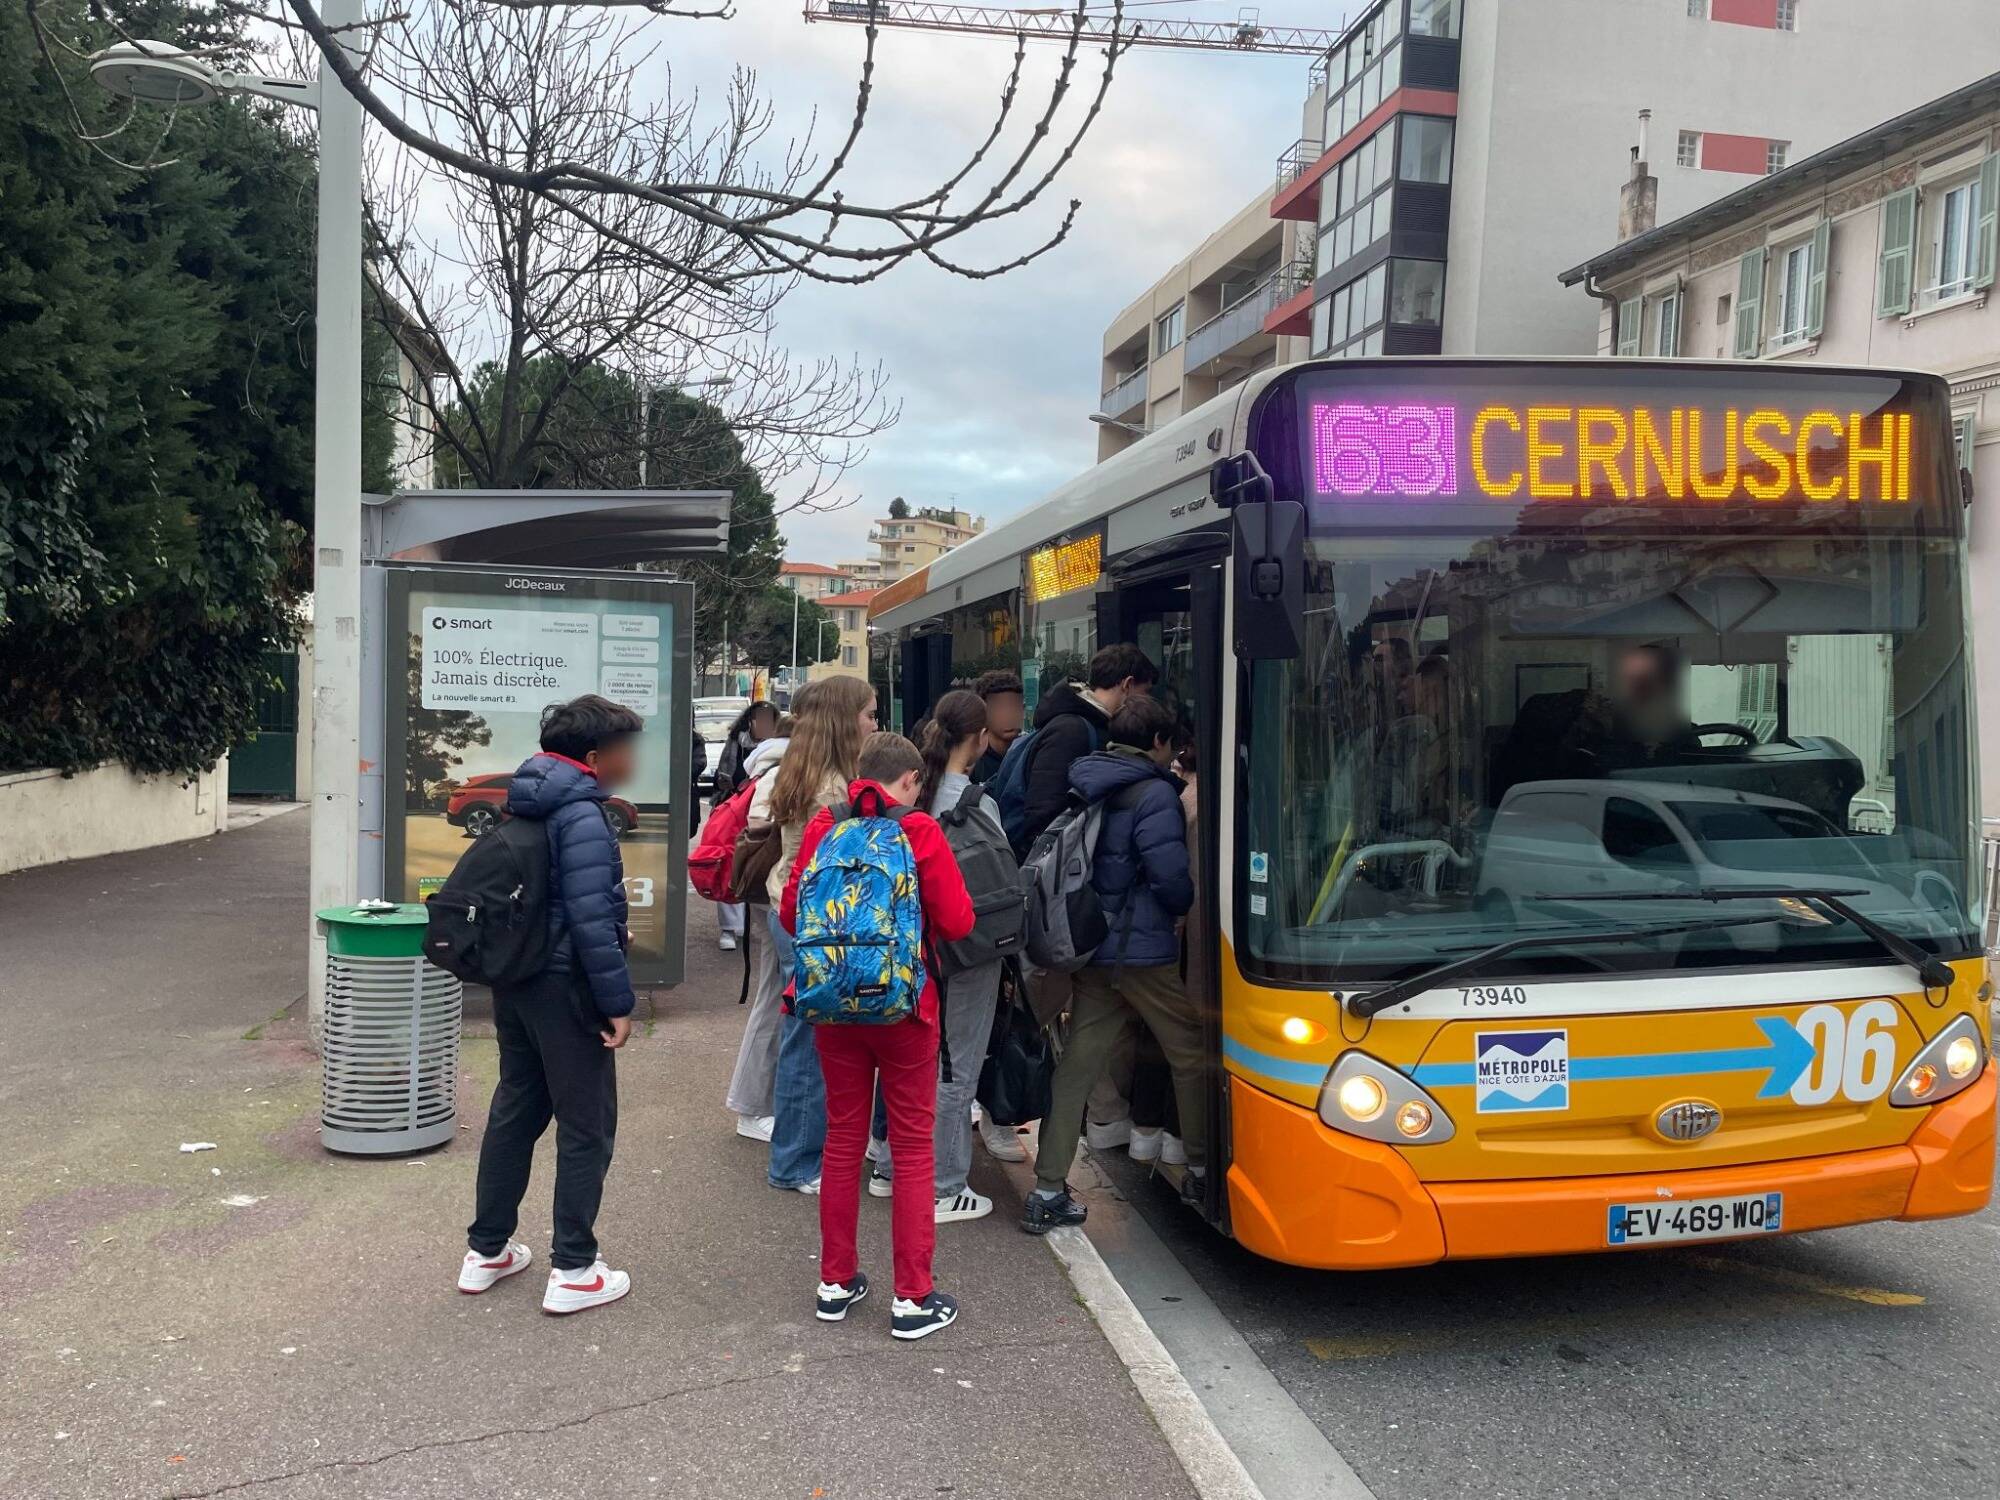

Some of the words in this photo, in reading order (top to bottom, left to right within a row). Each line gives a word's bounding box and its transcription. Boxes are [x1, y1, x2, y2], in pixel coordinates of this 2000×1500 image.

[1318, 404, 1451, 494] 63
[1471, 406, 1912, 500] CERNUSCHI
[504, 577, 566, 591] JCDecaux
[450, 619, 493, 630] smart
[433, 649, 474, 665] 100%
[480, 647, 568, 671] Électrique.
[432, 670, 488, 686] Jamais
[493, 671, 561, 688] discrète.
[432, 693, 441, 701] La
[443, 694, 479, 702] nouvelle
[480, 695, 503, 703] smart
[1458, 986, 1527, 1006] 73940
[1790, 1001, 1898, 1105] 06
[1479, 1058, 1566, 1076] MÉTROPOLE
[1479, 1077, 1501, 1085] NICE
[1505, 1074, 1530, 1084] CÔTE
[1534, 1074, 1566, 1083] D'AZUR
[1626, 1199, 1765, 1237] EV-469-WQ
